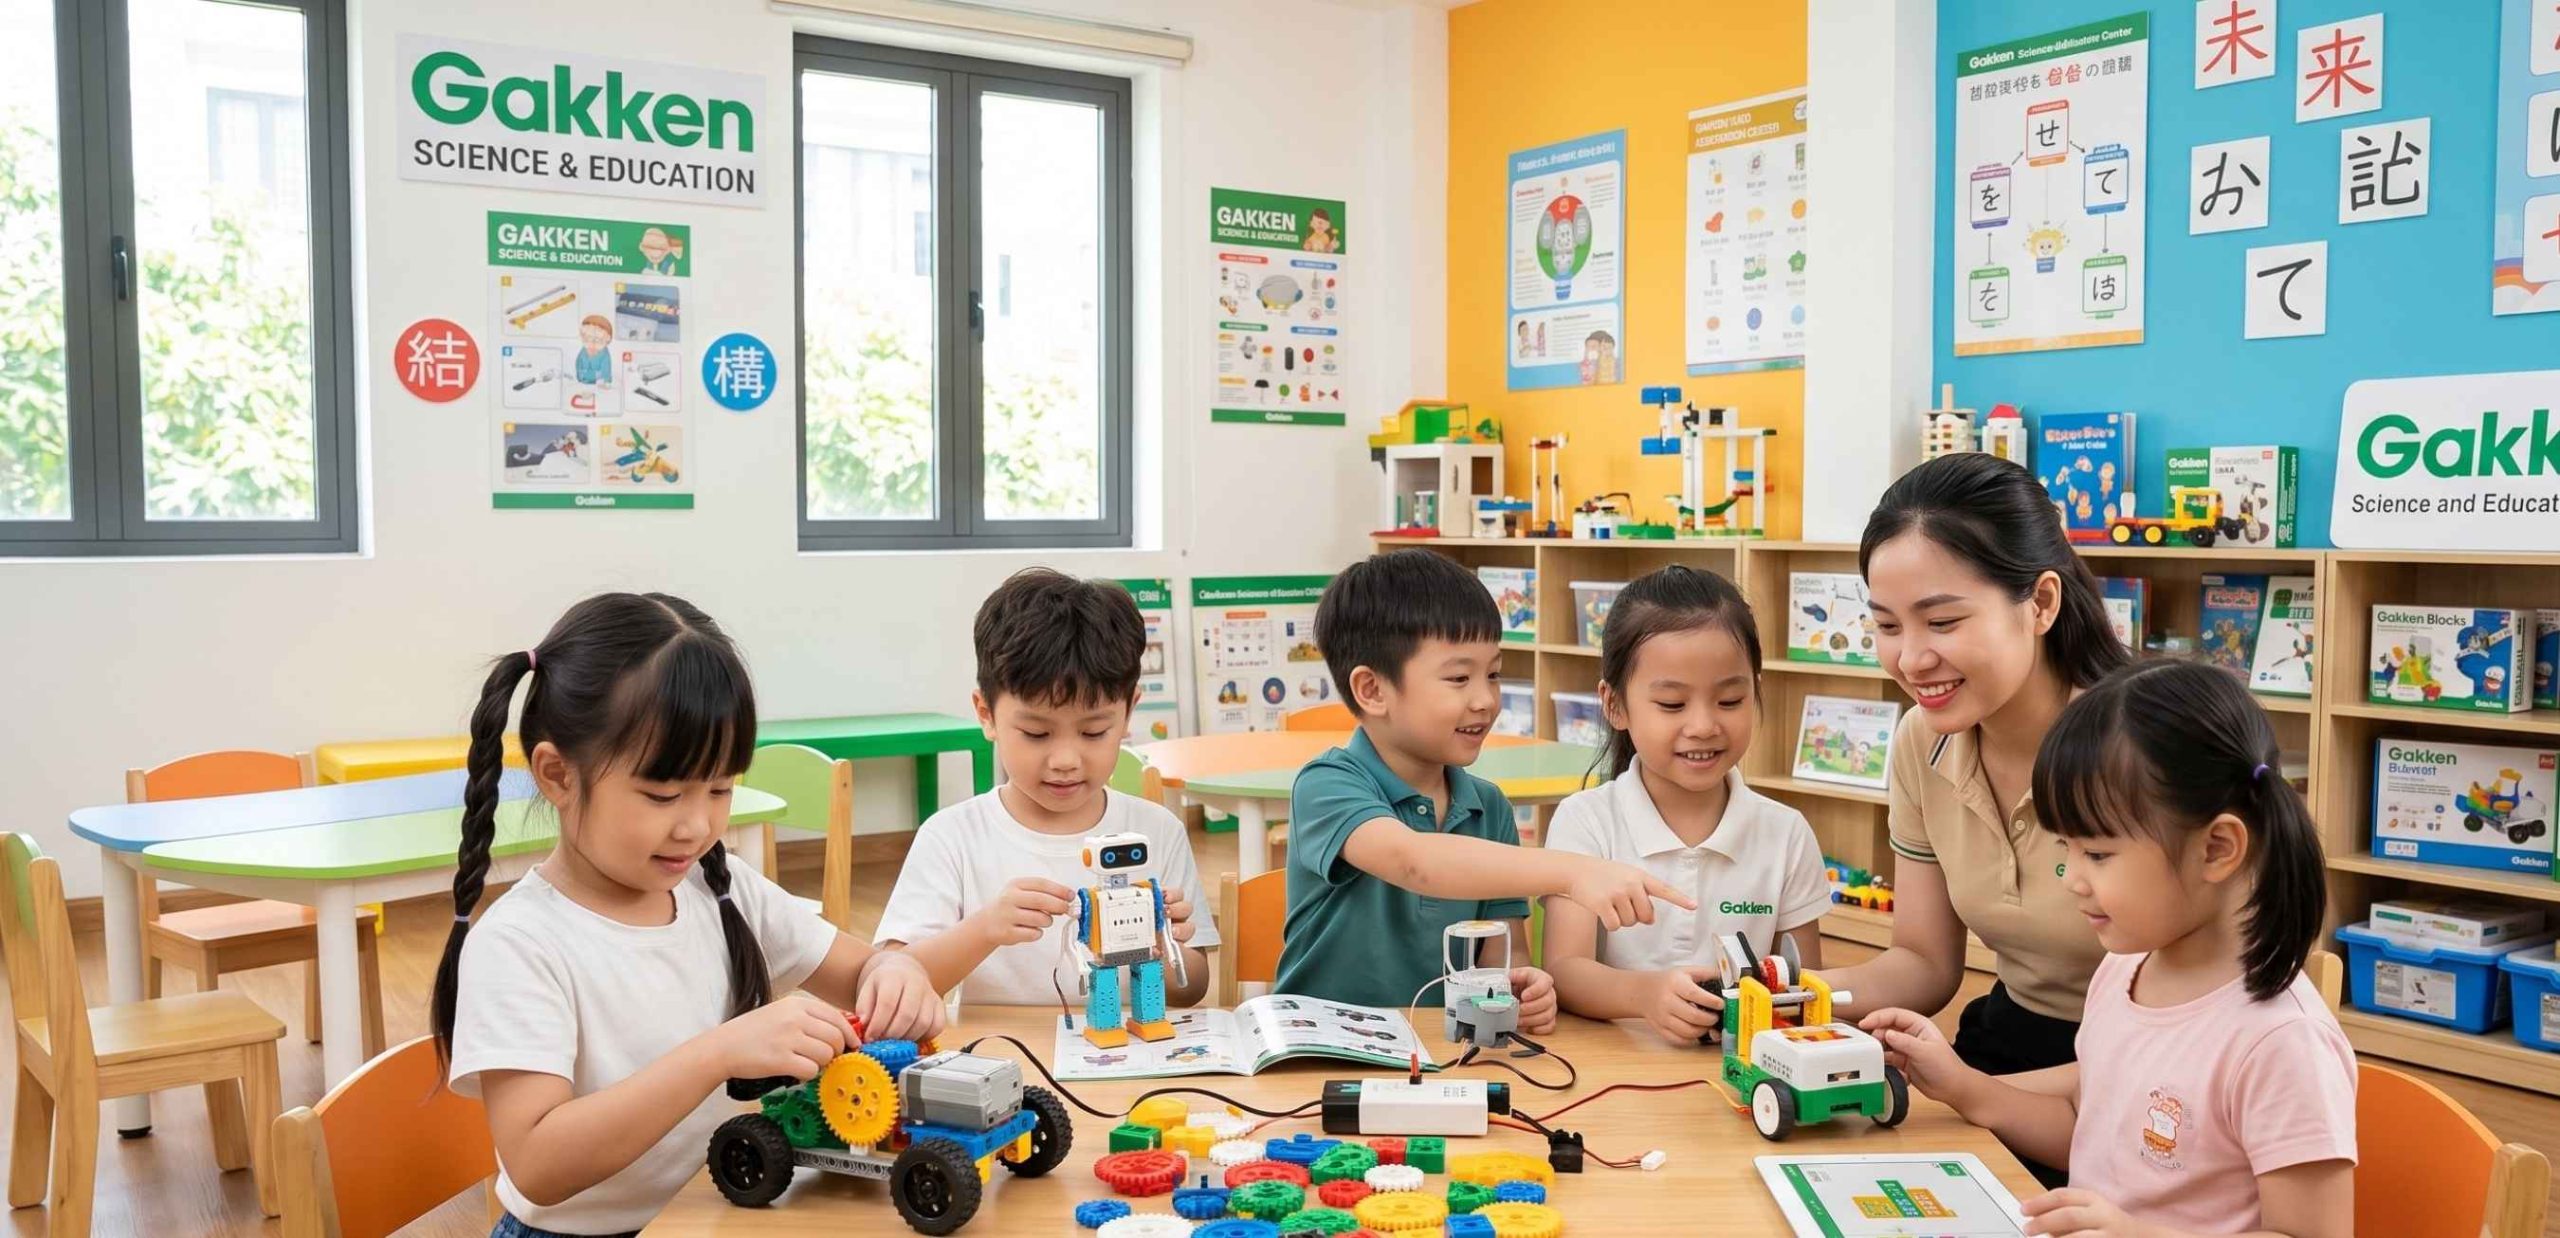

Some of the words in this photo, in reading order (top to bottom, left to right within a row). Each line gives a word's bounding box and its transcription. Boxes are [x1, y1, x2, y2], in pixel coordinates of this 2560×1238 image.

[2203, 0, 2269, 75] 未
[2303, 28, 2375, 108] 来
[412, 51, 754, 152] Gakken
[2035, 119, 2060, 147] せ
[414, 139, 549, 175] SCIENCE
[559, 152, 578, 178] &
[589, 155, 755, 193] EDUCATION
[2094, 168, 2117, 194] て
[2199, 151, 2261, 216] お
[1980, 184, 2001, 212] を
[1216, 206, 1296, 232] GAKKEN
[497, 223, 609, 251] GAKKEN
[498, 248, 547, 262] SCIENCE
[550, 253, 558, 262] &
[560, 252, 623, 266] EDUCATION
[2257, 258, 2313, 321] て
[407, 330, 467, 389] 結
[713, 345, 766, 399] 構
[2352, 494, 2431, 513] Science
[2437, 494, 2476, 513] and
[2483, 493, 2559, 513] Educat
[2377, 611, 2425, 624] Gakken
[2427, 613, 2467, 626] Blocks
[2388, 746, 2457, 766] Gakken
[1719, 901, 1773, 915] Gakken
